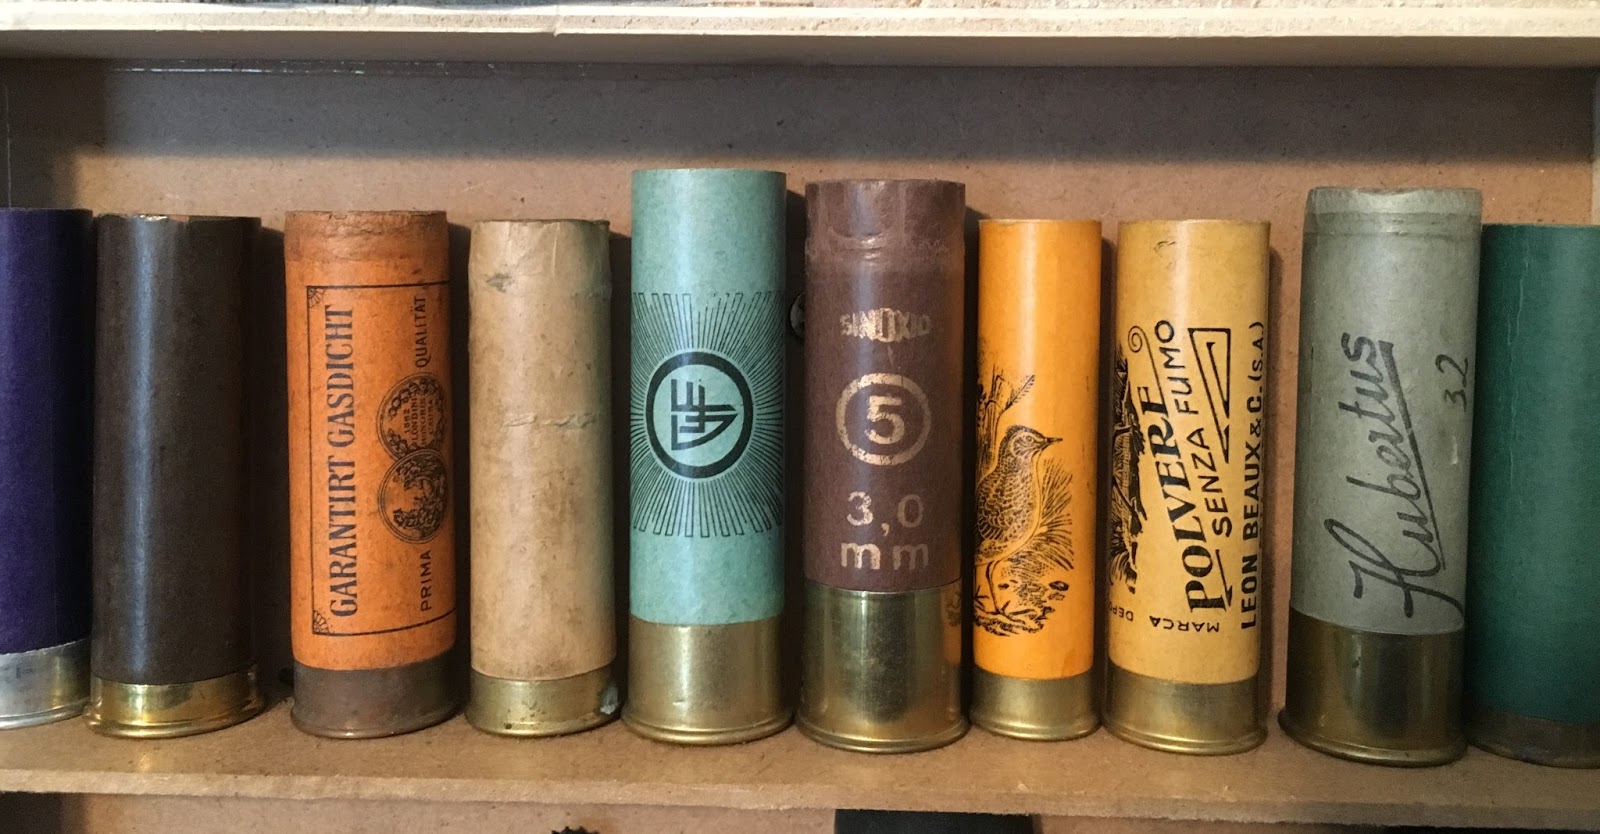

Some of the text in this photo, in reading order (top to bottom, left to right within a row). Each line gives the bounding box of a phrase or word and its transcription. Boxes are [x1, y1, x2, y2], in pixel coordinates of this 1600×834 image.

[839, 307, 931, 343] SINOXID
[864, 396, 905, 445] 5
[1154, 319, 1233, 538] SENZA FUMO
[324, 304, 358, 618] GARANTIRT GASDICHT
[410, 295, 432, 612] PRIMA QUALITÄT
[1137, 385, 1227, 613] POLVERE
[1323, 332, 1464, 618] Hubertus
[1149, 615, 1220, 633] MARCA
[1241, 554, 1258, 630] LEON
